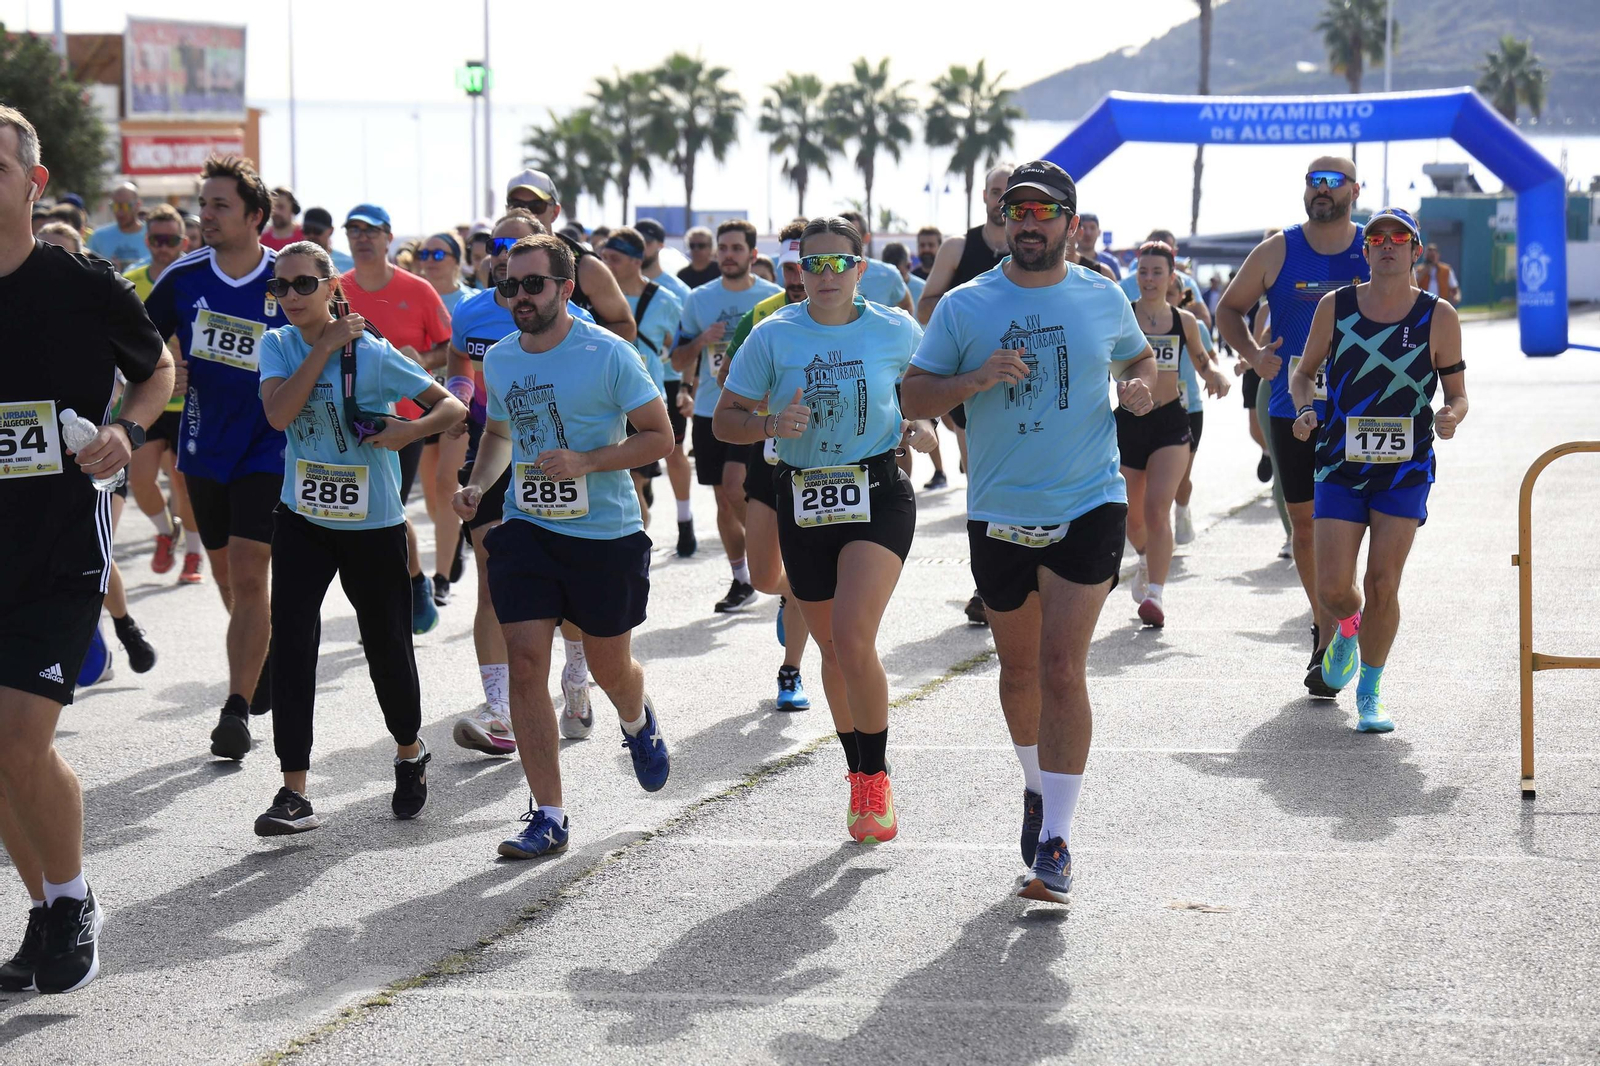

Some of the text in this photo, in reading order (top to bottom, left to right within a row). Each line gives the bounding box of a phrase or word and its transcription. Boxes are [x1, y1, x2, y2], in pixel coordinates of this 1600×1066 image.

[1200, 102, 1374, 121] AYUNTAMIENTO
[1211, 123, 1362, 141] DE ALGECIRAS
[1024, 314, 1040, 330] XXV
[1032, 325, 1064, 335] CARRERA
[202, 328, 255, 355] 188
[1032, 331, 1066, 350] URBANA
[827, 350, 842, 364] XXV
[834, 359, 863, 368] CARRERA
[833, 365, 866, 380] URBANA
[1058, 346, 1068, 409] ALGECIRAS
[523, 374, 537, 387] XXV
[528, 383, 554, 393] CARRERA
[528, 389, 556, 405] URBANA
[858, 380, 867, 434] ALGECIRAS
[3, 410, 38, 420] URBANA
[3, 418, 39, 428] ALGECIRAS
[1354, 432, 1406, 451] 175
[306, 467, 330, 476] CARRERA
[804, 473, 828, 482] CARRERA
[804, 480, 821, 488] CIUDAD
[302, 479, 359, 505] 286
[522, 481, 577, 503] 285
[801, 484, 861, 511] 280
[39, 671, 64, 684] adidas
